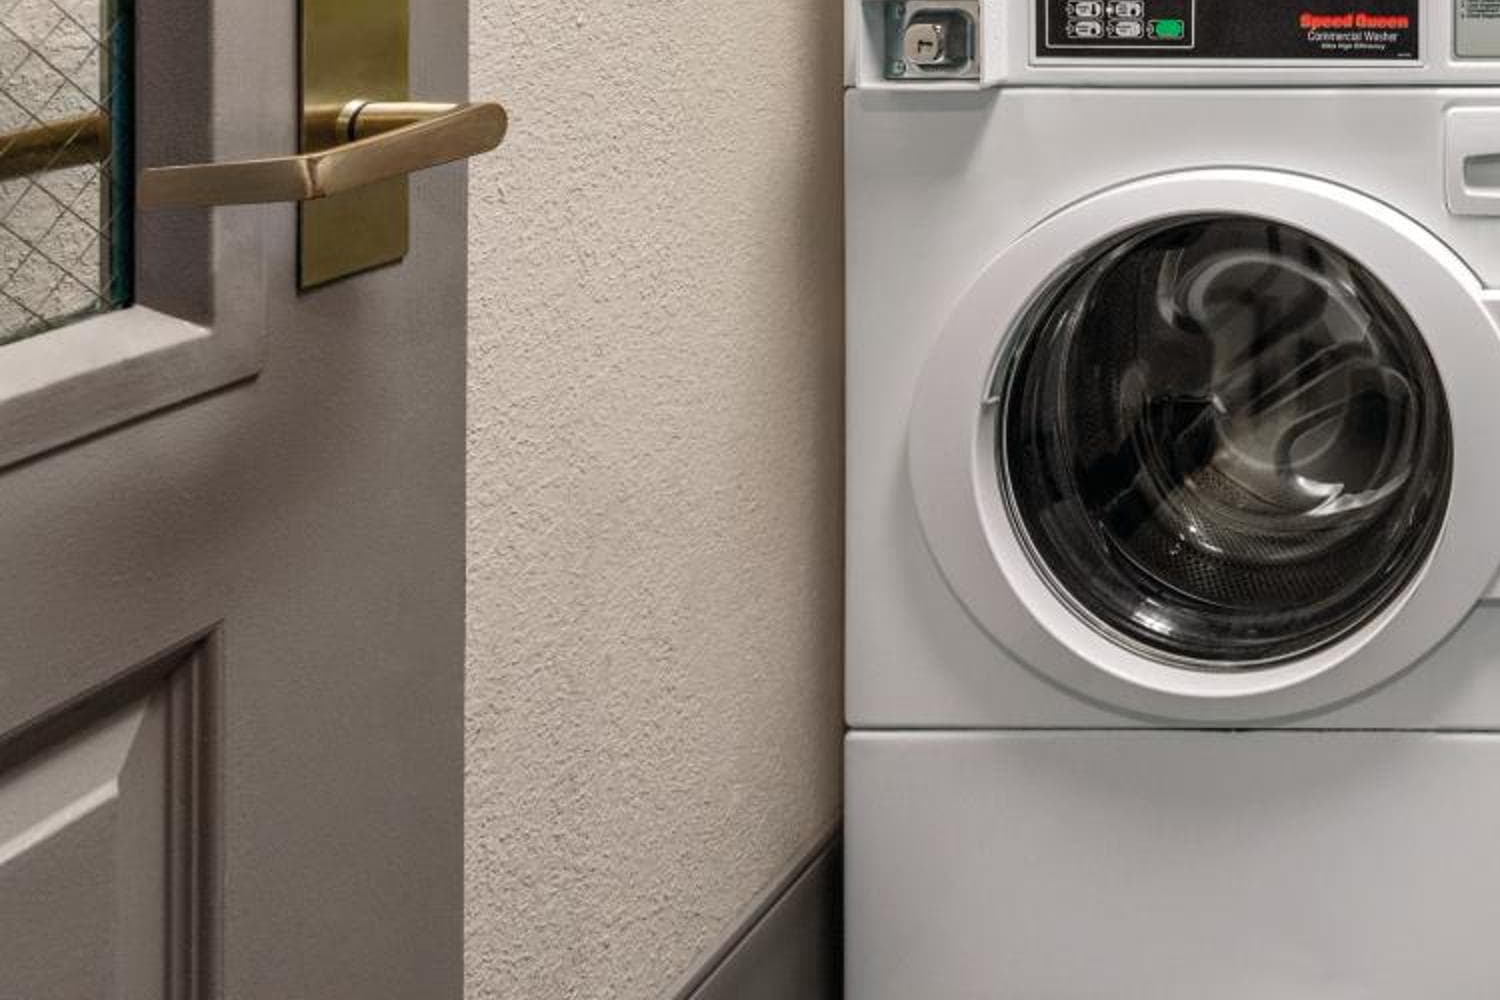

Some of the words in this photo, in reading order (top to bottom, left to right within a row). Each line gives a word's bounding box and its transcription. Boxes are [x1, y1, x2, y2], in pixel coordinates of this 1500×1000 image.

[1300, 12, 1353, 31] Speed
[1355, 12, 1409, 29] Queen
[1307, 30, 1363, 42] Commercial
[1364, 30, 1398, 42] Washer
